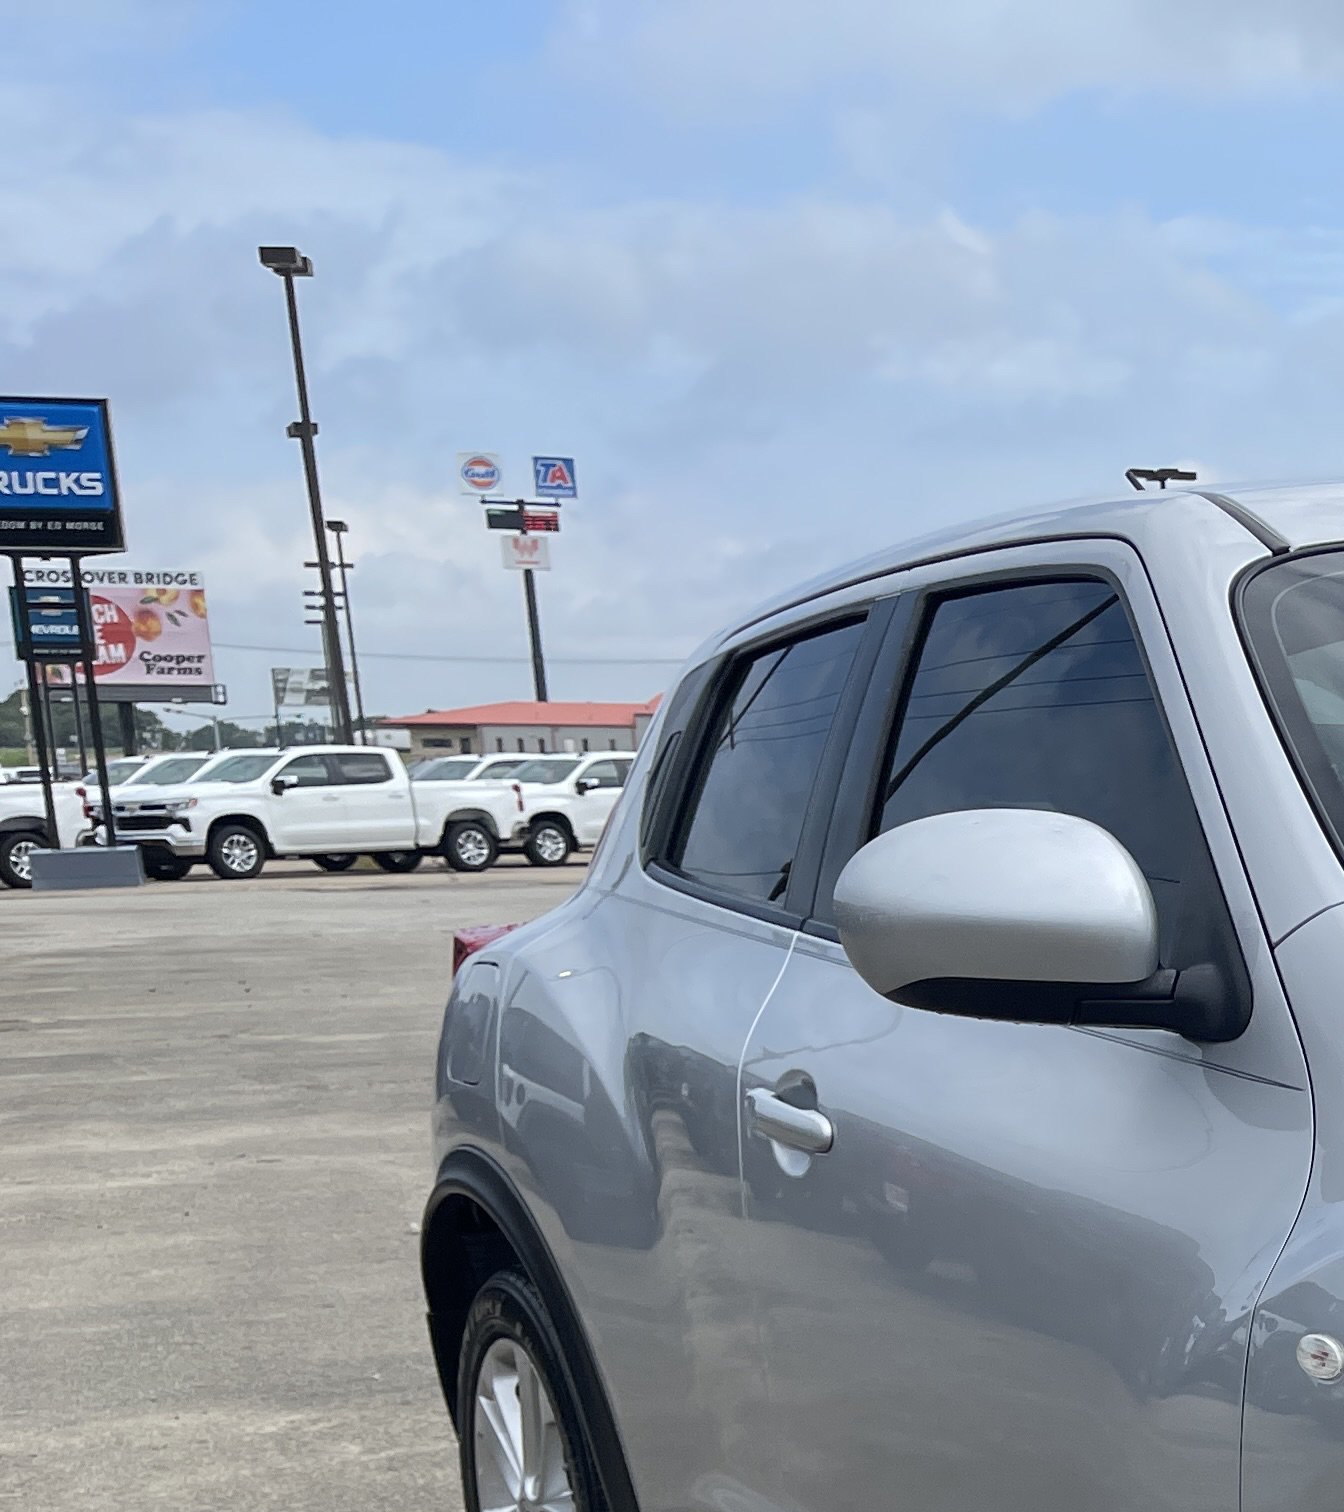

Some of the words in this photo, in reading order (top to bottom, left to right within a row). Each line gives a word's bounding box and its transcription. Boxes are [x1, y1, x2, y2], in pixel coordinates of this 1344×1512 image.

[537, 460, 573, 487] TA
[0, 471, 104, 496] RUCKS
[23, 570, 128, 585] CROSOVER
[133, 572, 199, 586] BRIDGE
[139, 650, 205, 665] Cooper
[145, 664, 203, 676] Farms
